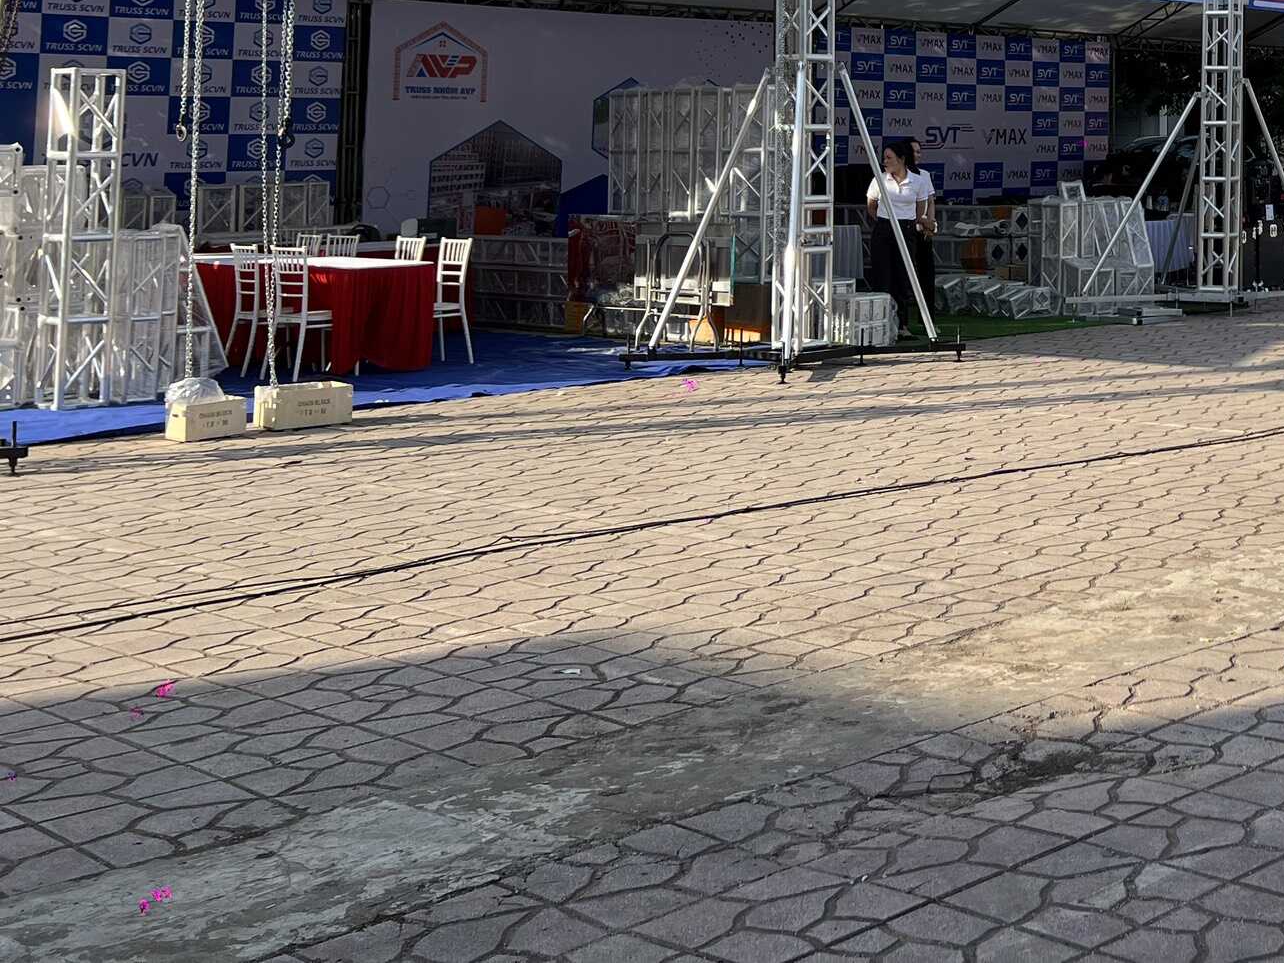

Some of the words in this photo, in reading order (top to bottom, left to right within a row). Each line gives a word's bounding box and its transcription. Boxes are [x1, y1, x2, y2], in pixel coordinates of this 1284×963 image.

[47, 2, 77, 12] TRUSS
[79, 4, 105, 13] SCVN
[114, 5, 143, 15] TRUSS
[145, 7, 169, 16] SCVN
[45, 42, 75, 51] TRUSS
[77, 44, 102, 52] SCVN
[112, 44, 141, 53] TRUSS
[143, 46, 168, 54] SCVN
[141, 84, 166, 92] SCVN
[119, 152, 159, 167] CVN
